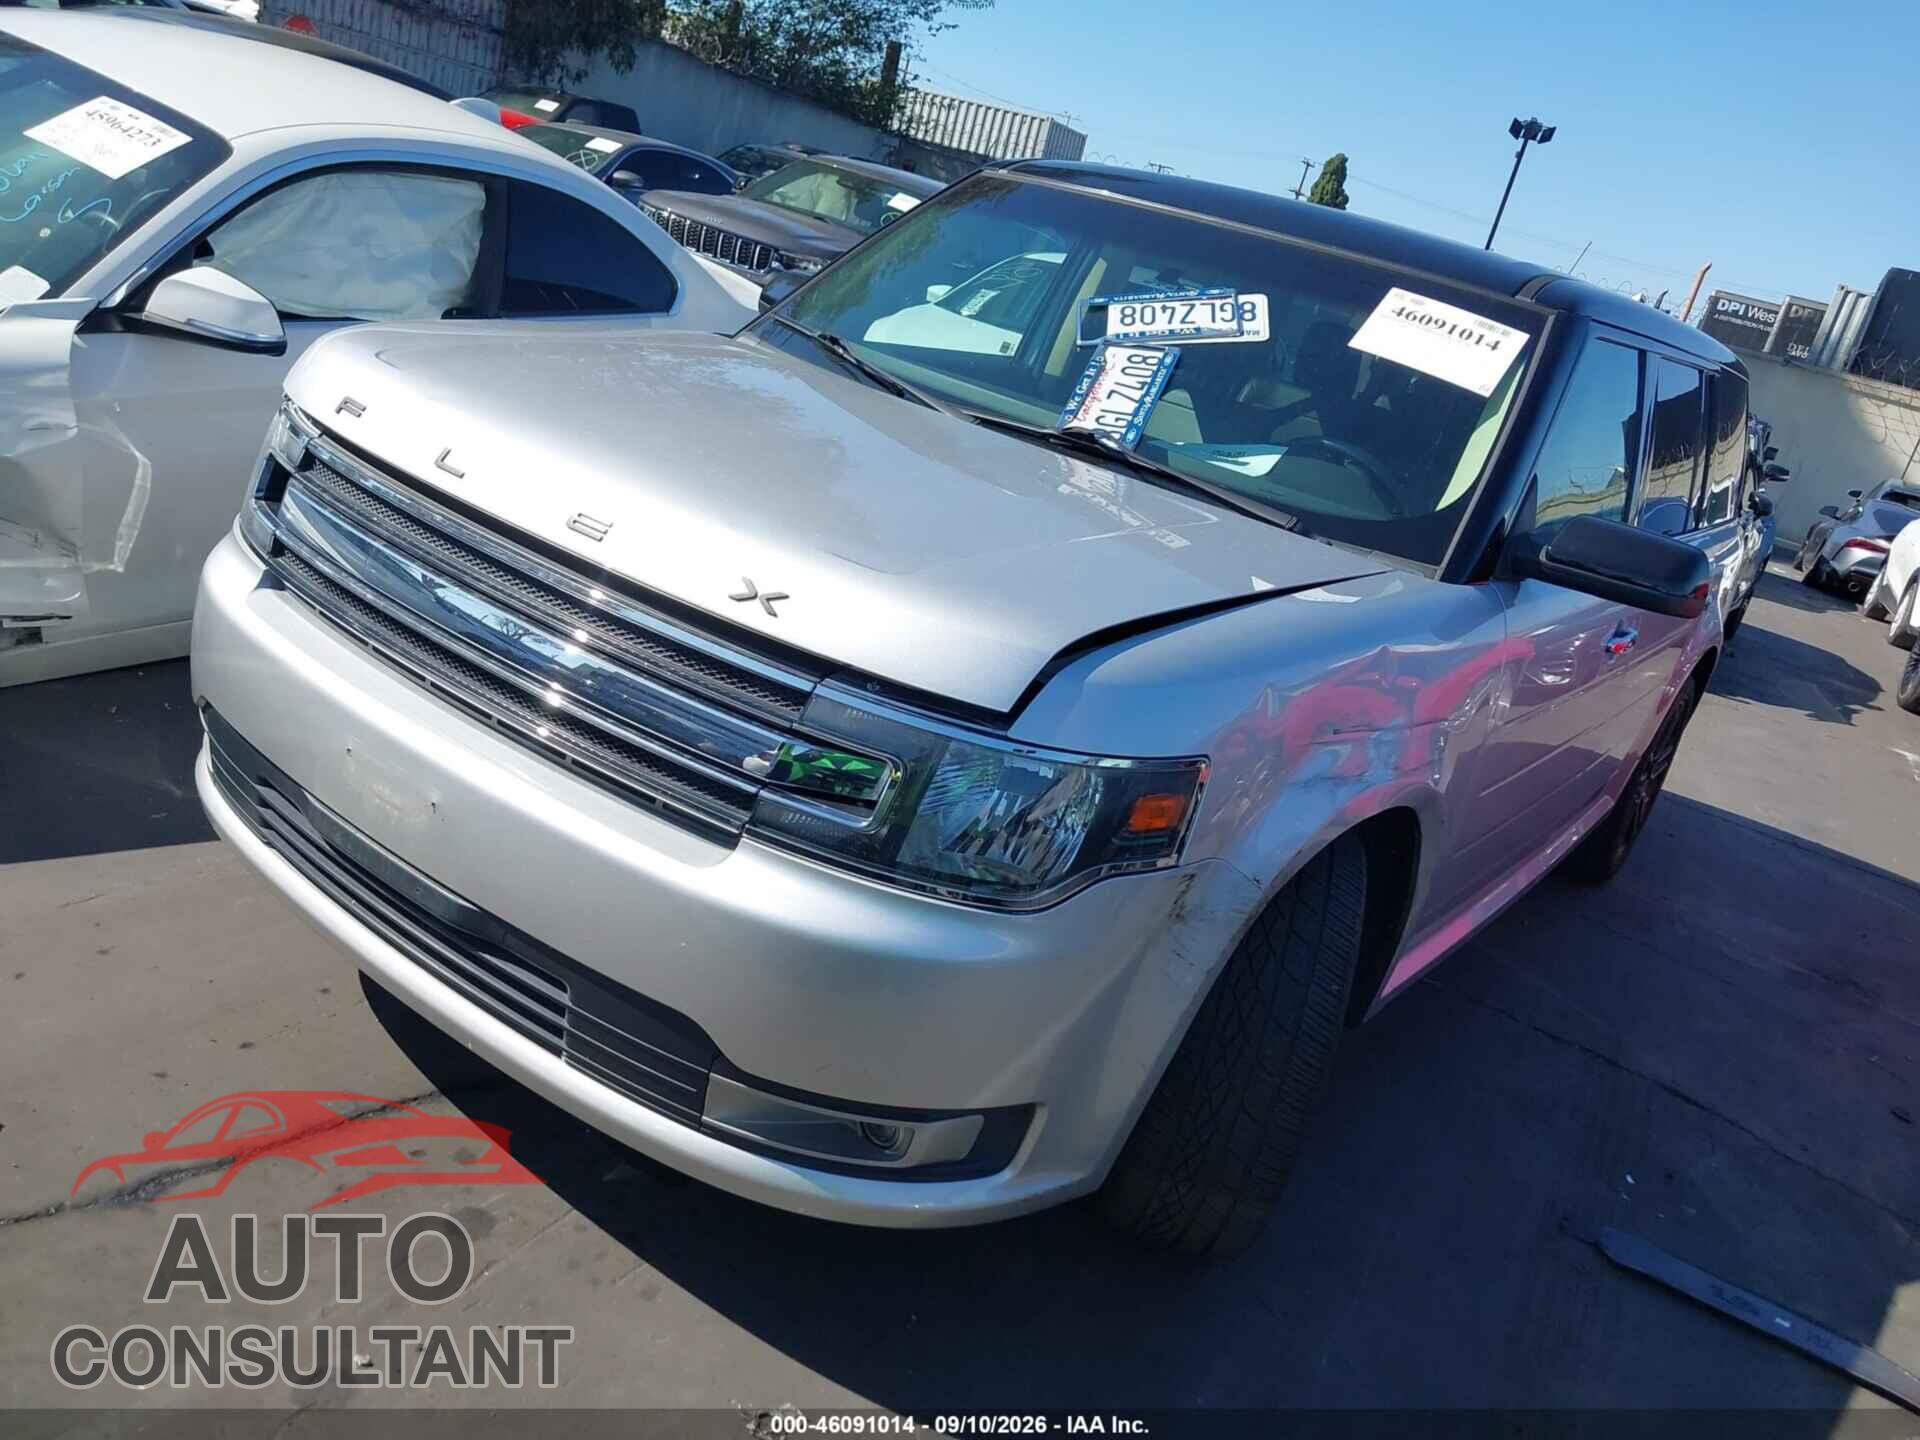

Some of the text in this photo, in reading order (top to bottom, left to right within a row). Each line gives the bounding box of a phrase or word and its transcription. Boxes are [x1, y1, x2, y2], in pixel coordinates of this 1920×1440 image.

[85, 109, 161, 147] 45964273
[1120, 301, 1257, 326] 8GLZ408
[1716, 299, 1777, 323] DPI Wes
[1391, 306, 1501, 351] 46091014
